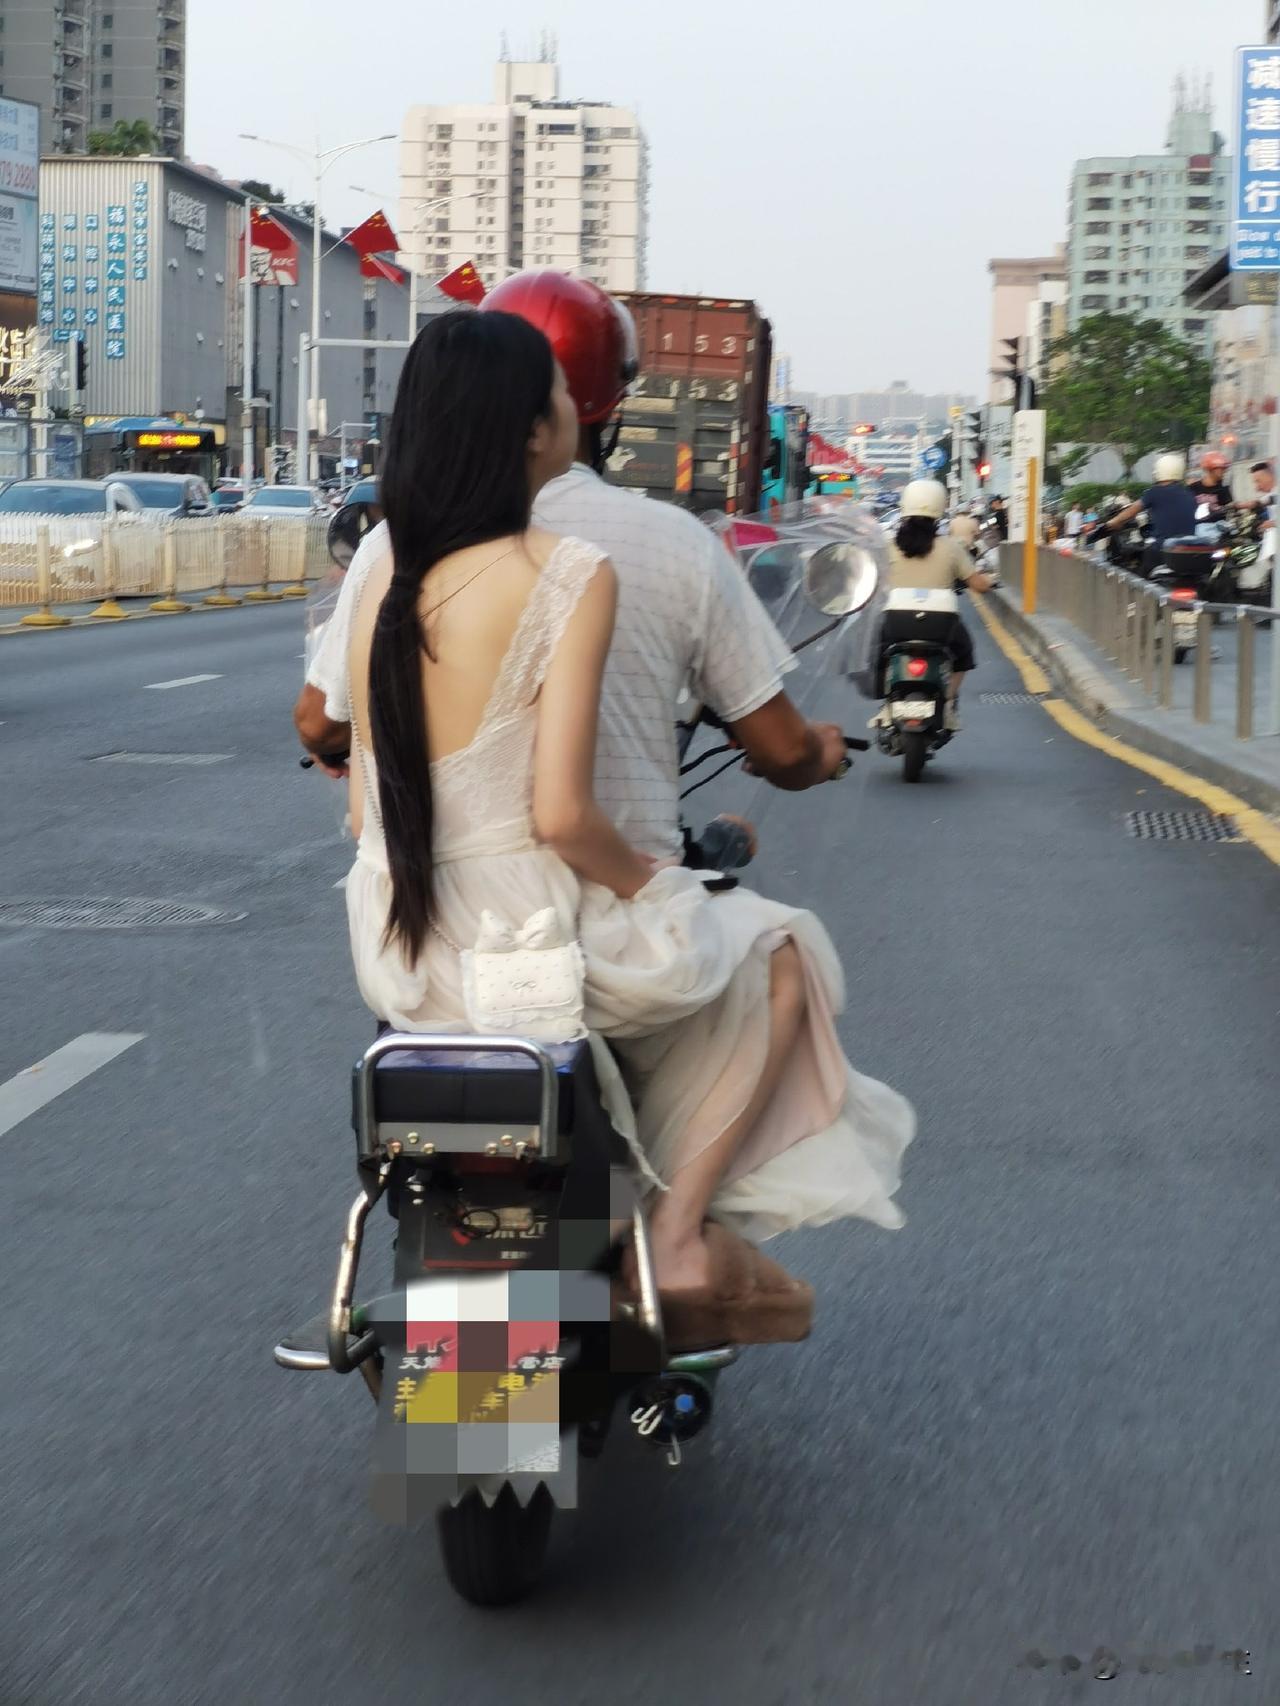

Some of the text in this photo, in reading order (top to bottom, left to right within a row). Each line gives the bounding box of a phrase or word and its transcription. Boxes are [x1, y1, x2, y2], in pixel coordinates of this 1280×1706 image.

[1244, 56, 1280, 213] 减速慢行
[107, 206, 125, 359] 福永人民医院
